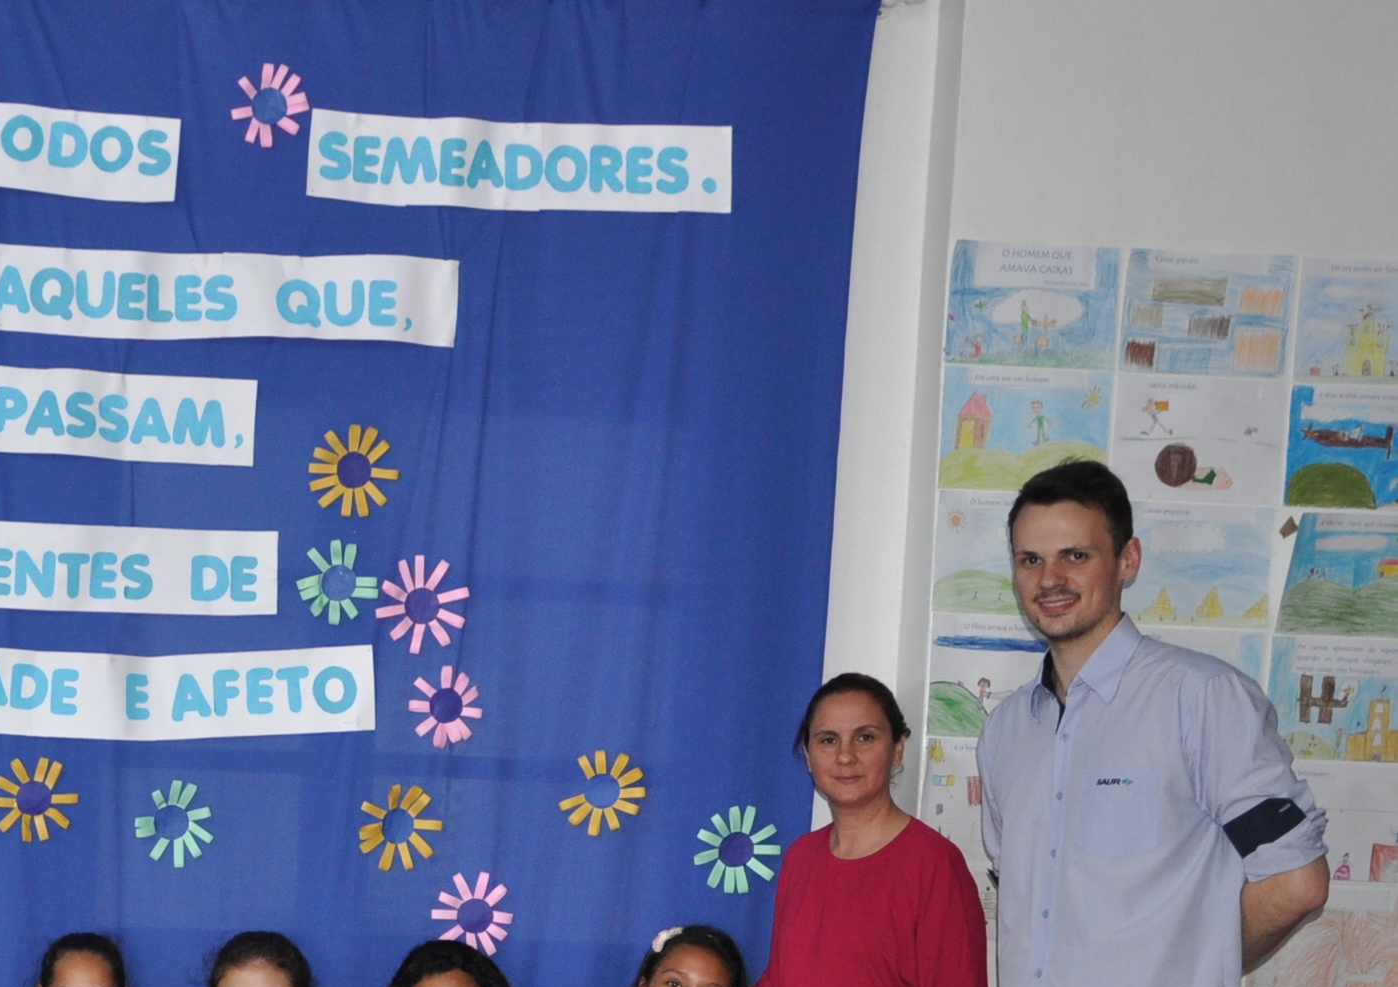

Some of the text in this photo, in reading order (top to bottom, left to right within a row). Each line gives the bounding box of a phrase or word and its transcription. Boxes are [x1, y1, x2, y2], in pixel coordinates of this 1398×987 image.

[319, 132, 717, 194] SEMEADORES.
[999, 264, 1072, 275] AMAVA CAIXAS
[1012, 249, 1049, 258] HOMEM
[1051, 251, 1072, 260] QUE
[276, 280, 412, 329] QUE,
[191, 555, 258, 601] DE
[126, 674, 150, 720] E
[172, 666, 357, 721] AFETO
[1096, 778, 1121, 786] SAUR
